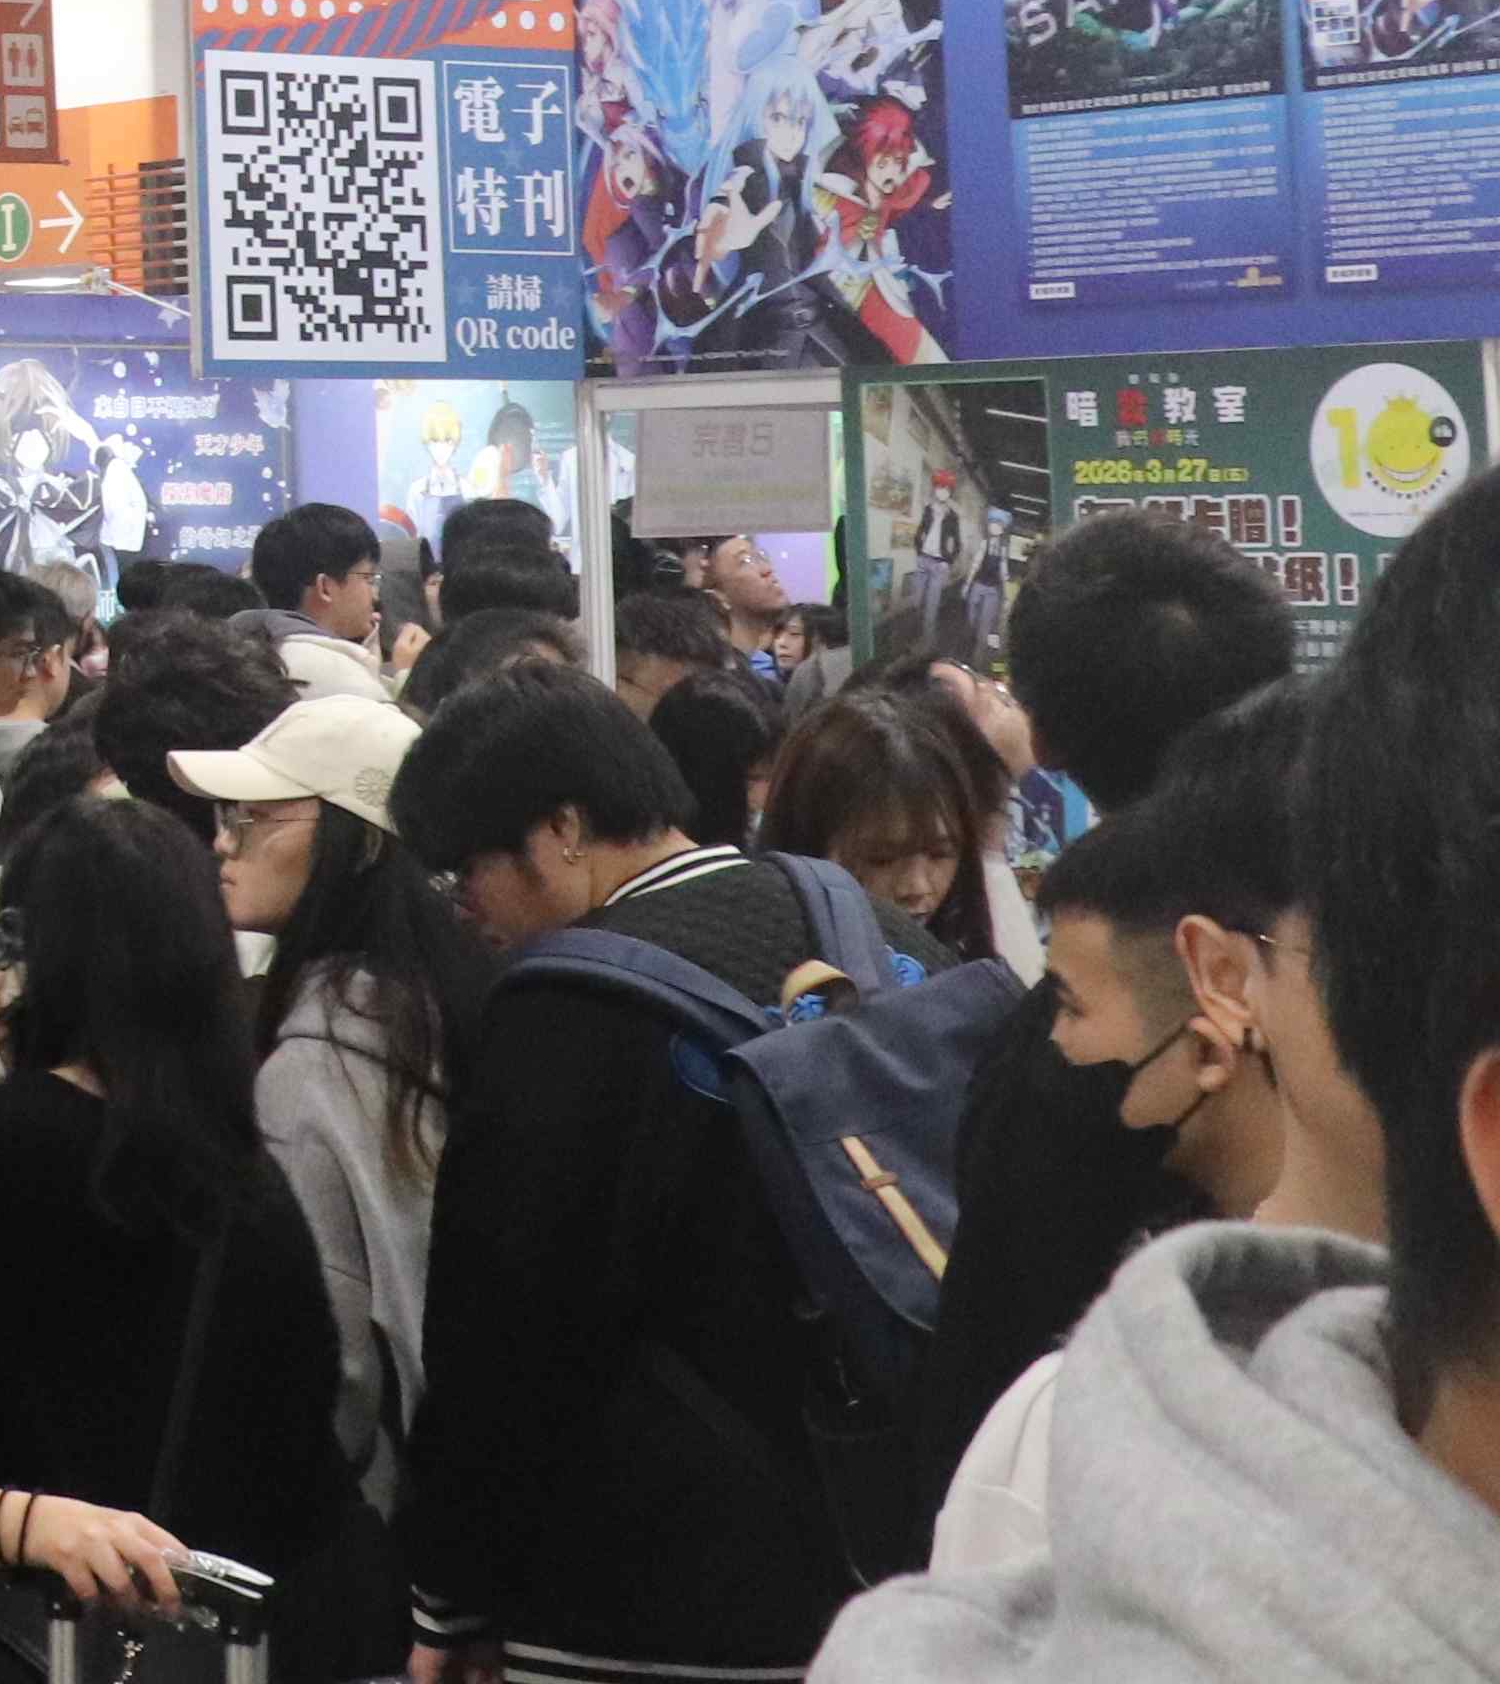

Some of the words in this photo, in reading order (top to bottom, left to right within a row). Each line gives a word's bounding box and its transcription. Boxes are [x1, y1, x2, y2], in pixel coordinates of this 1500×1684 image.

[452, 74, 563, 145] 電子
[455, 168, 566, 238] 特刊
[484, 273, 542, 313] 請掃
[455, 318, 500, 356] QR
[506, 315, 576, 351] code
